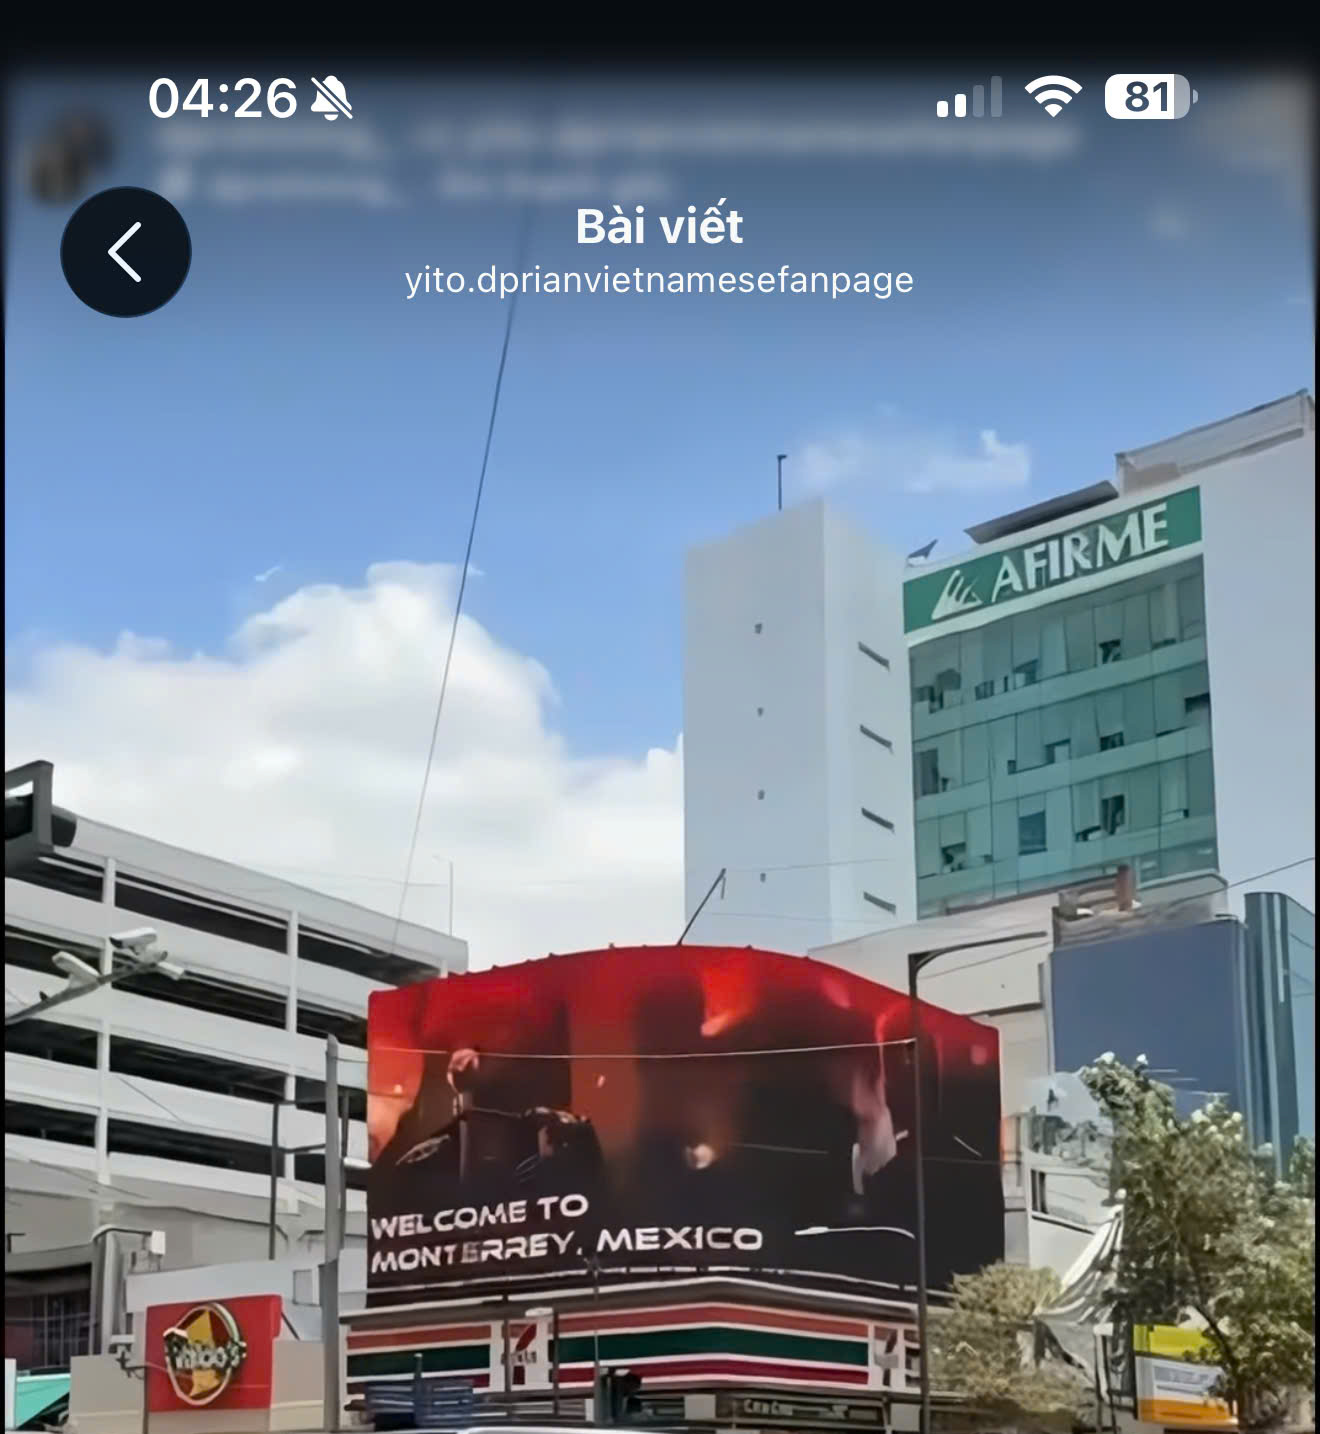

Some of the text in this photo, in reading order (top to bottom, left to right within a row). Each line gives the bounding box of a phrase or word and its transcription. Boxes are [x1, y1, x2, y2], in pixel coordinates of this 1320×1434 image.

[992, 502, 1169, 602] AFIRME
[371, 1193, 589, 1240] WELCOME TO
[596, 1225, 763, 1252] MEXICO
